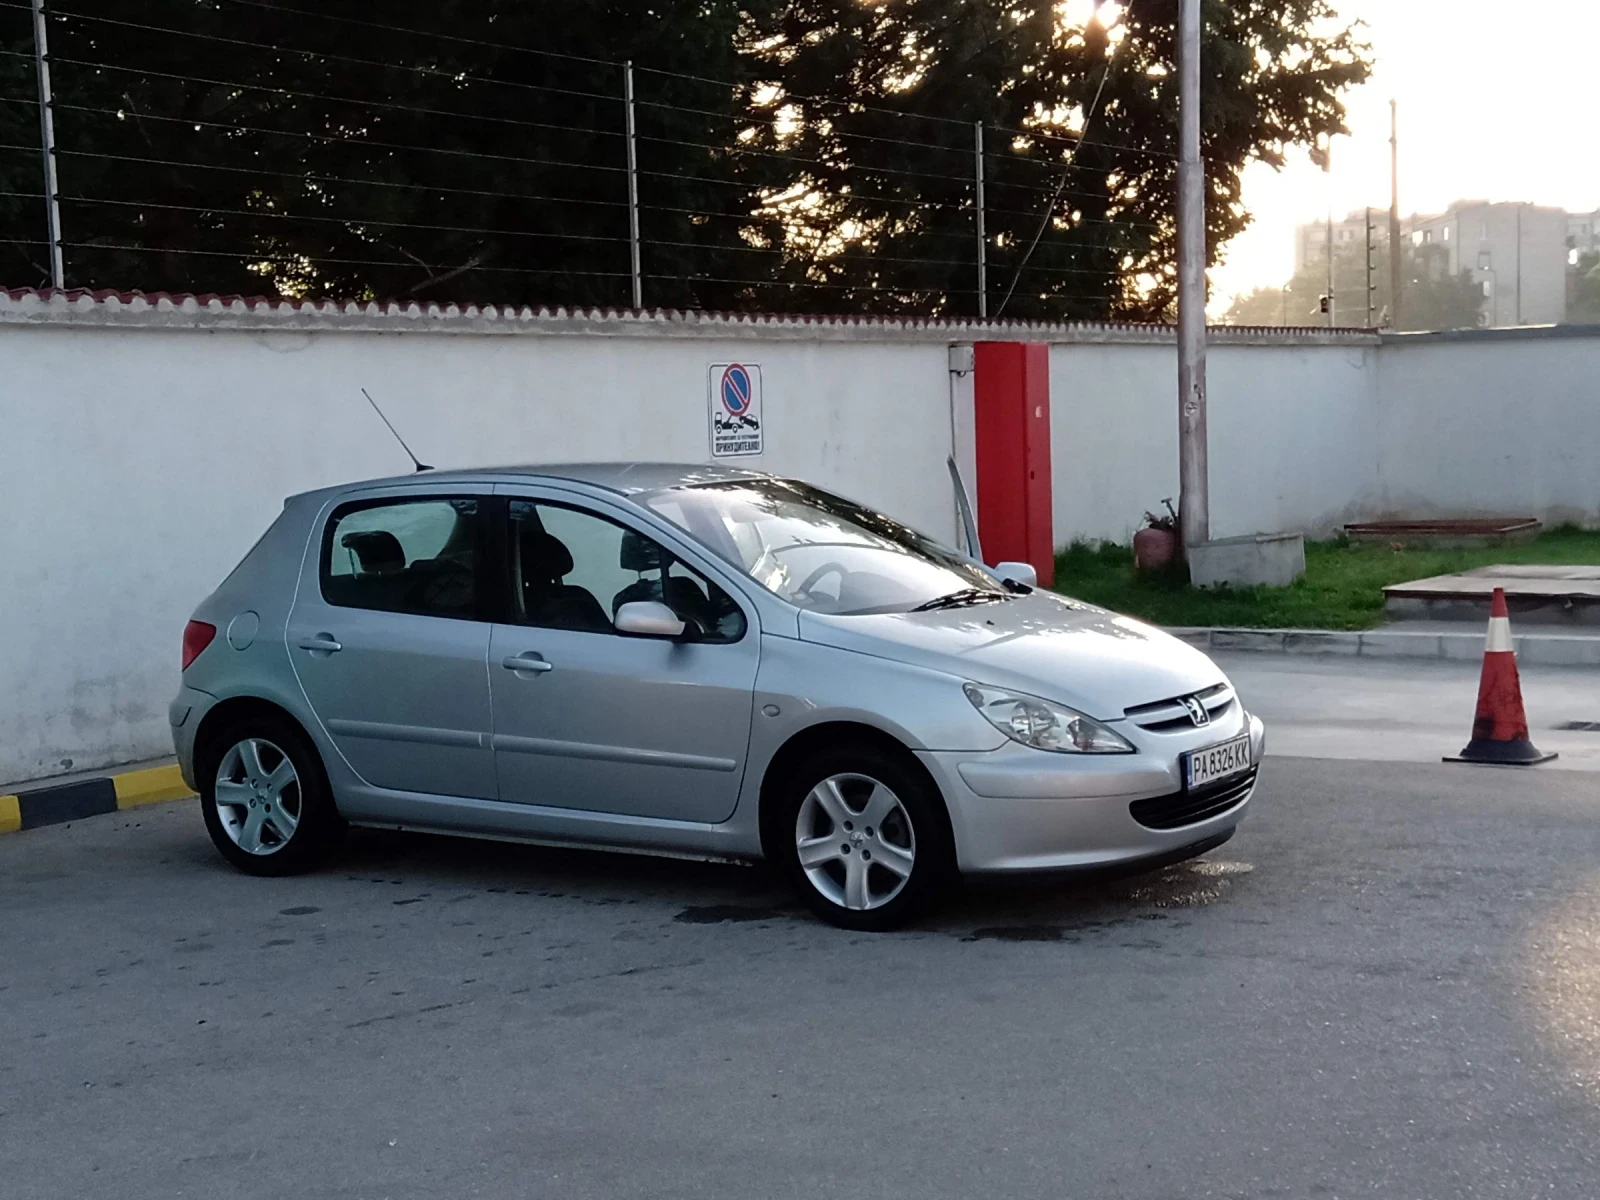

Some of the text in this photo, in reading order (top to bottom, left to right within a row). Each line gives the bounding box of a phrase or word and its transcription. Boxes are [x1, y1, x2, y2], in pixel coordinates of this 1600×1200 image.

[1193, 741, 1248, 782] PA 8326 KK
